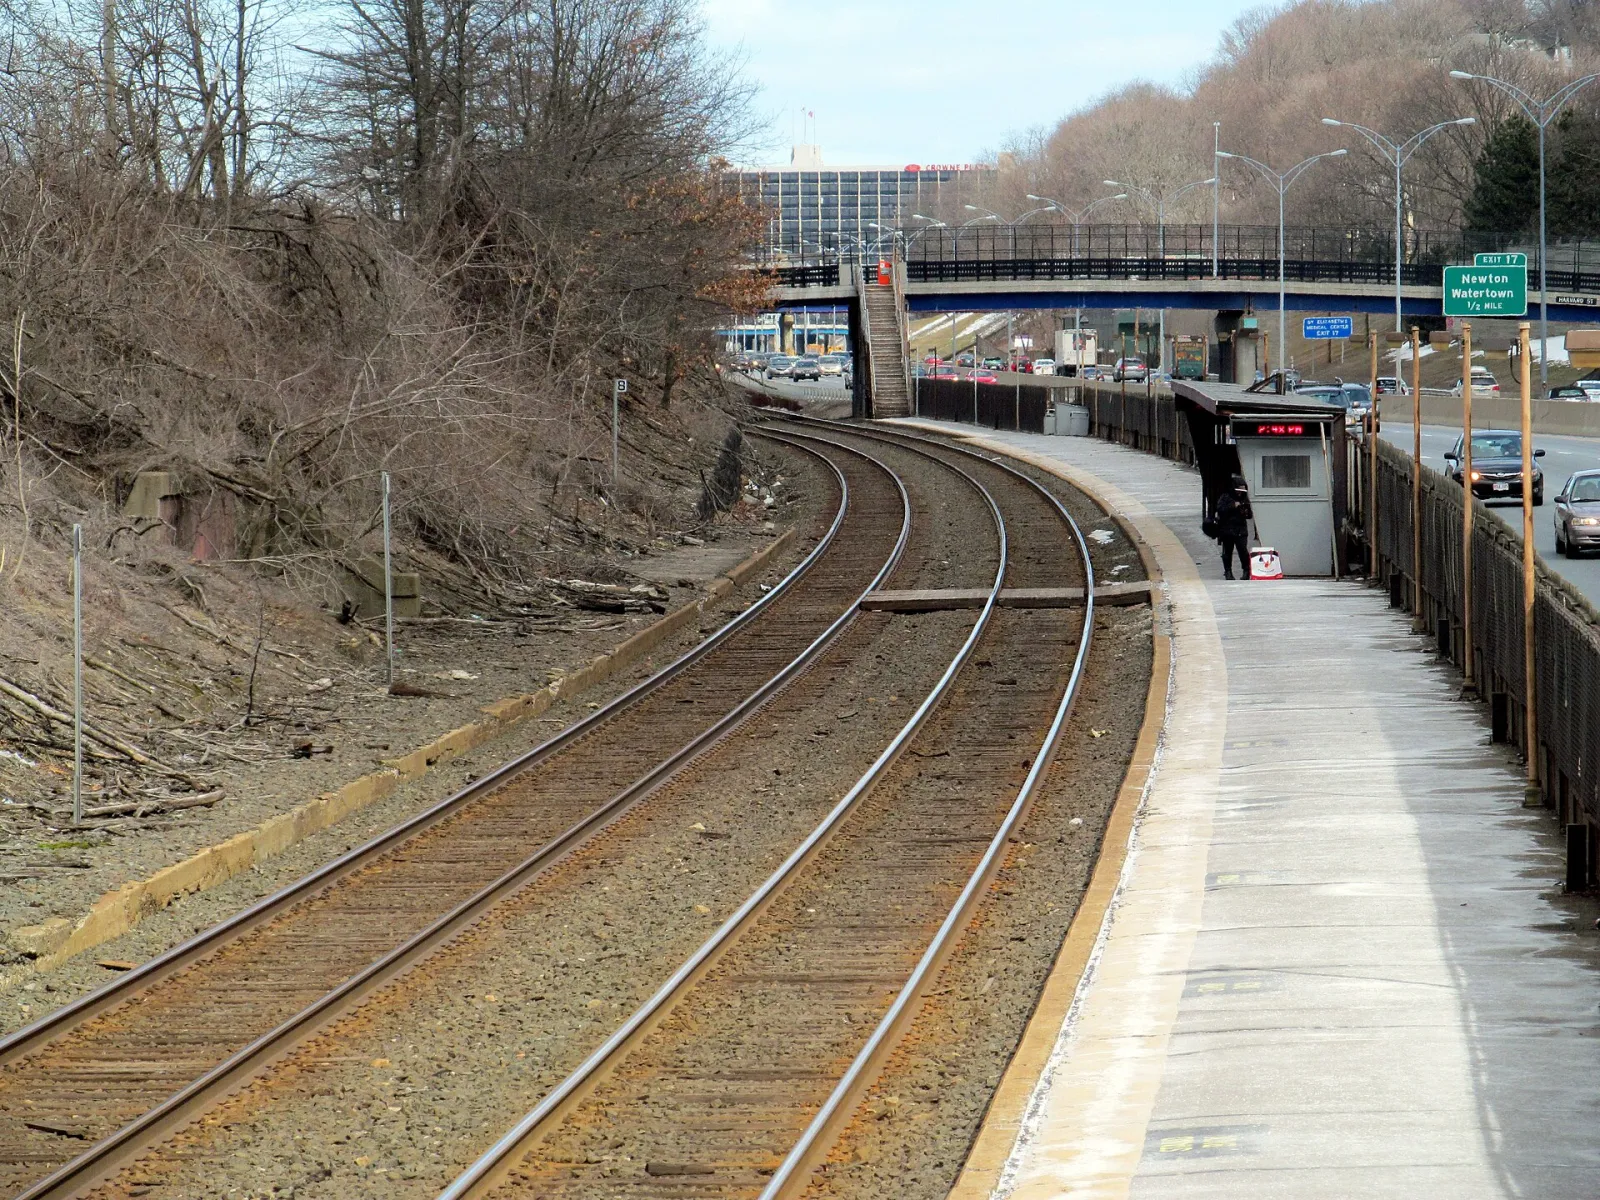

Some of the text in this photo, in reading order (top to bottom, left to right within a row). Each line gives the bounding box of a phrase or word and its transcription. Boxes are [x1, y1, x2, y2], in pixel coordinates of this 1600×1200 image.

[1506, 255, 1518, 264] 17
[1461, 273, 1508, 284] Newton
[1451, 288, 1514, 298] Watertown
